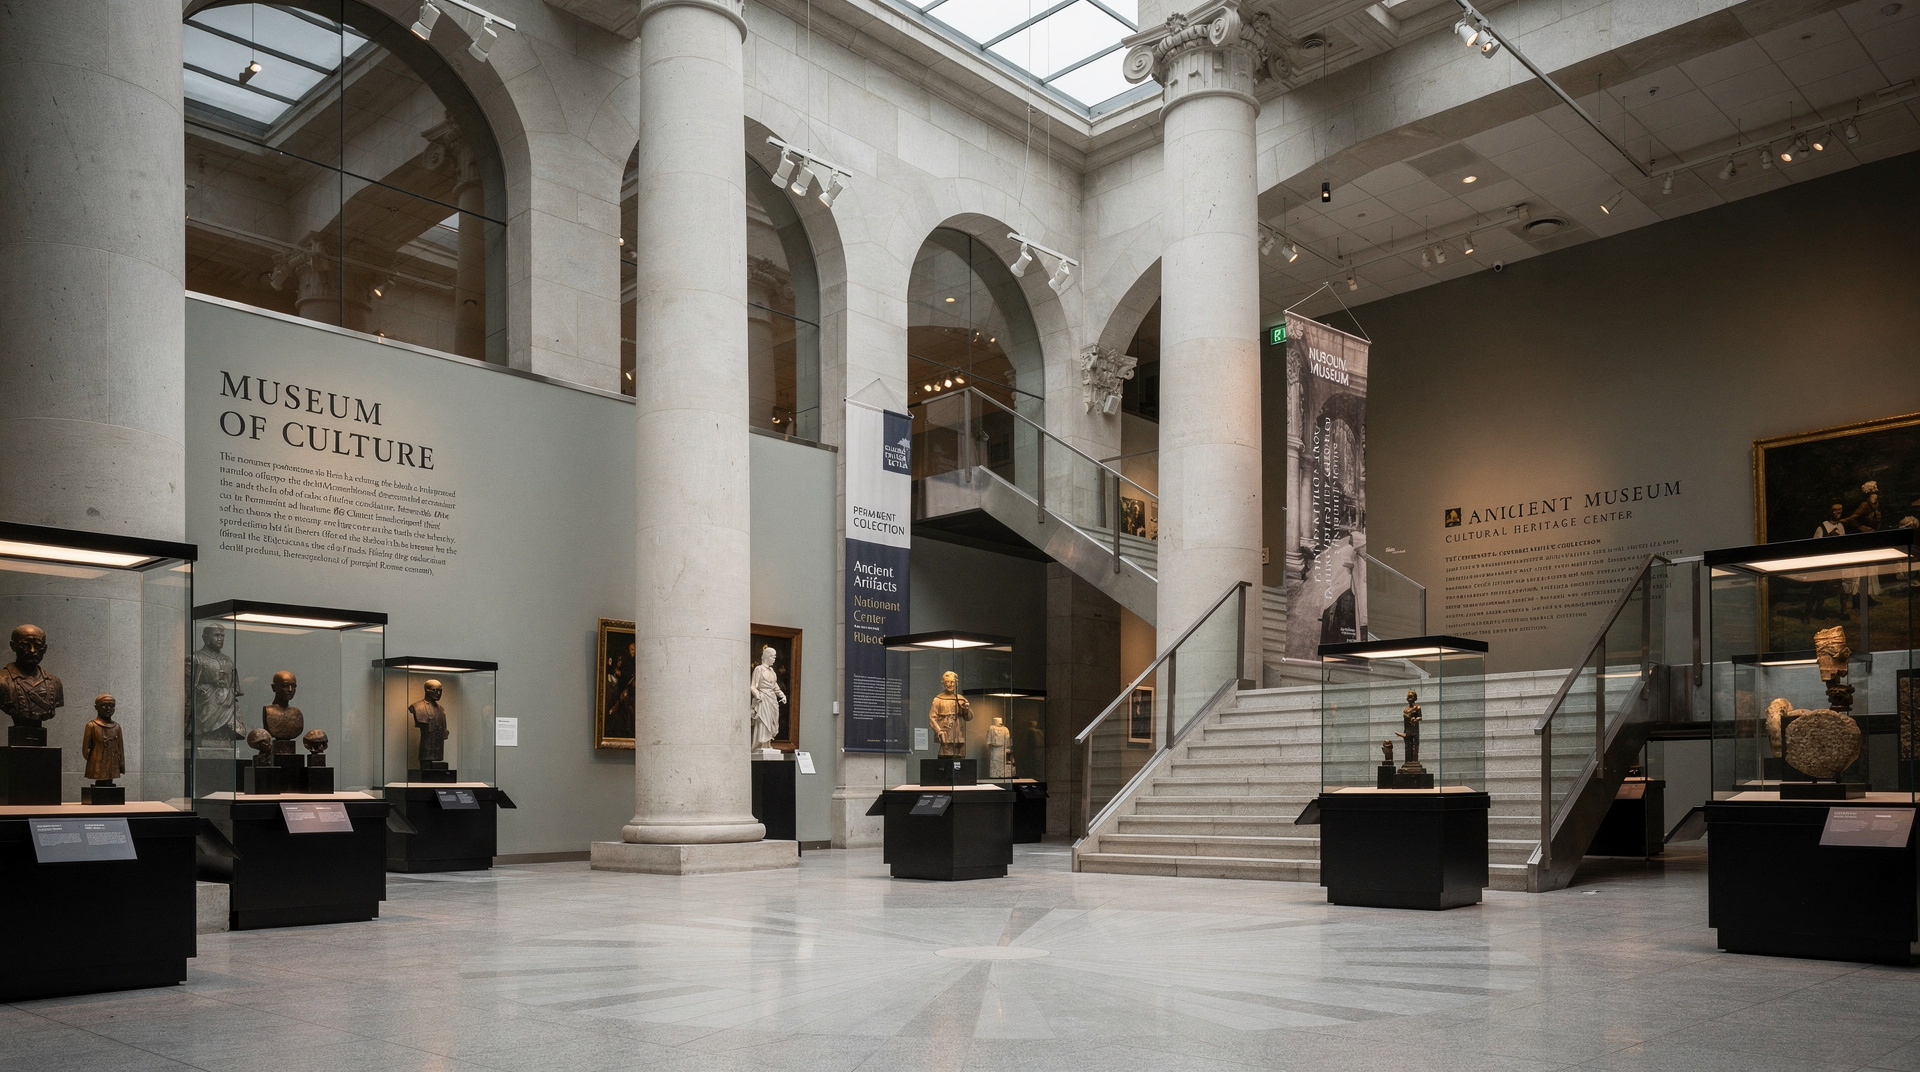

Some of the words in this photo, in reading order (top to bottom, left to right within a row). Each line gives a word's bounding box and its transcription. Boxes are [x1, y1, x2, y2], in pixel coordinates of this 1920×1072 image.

[1310, 361, 1349, 386] MUSEUM
[220, 370, 382, 426] MUSEUM
[219, 410, 267, 440] OF
[282, 421, 435, 470] CULTURE
[1584, 480, 1682, 508] MUSEUM
[1445, 526, 1508, 543] CULTURAL
[1514, 518, 1577, 534] HERITAGE
[1584, 510, 1633, 525] CENTER
[853, 560, 894, 578] Ancient
